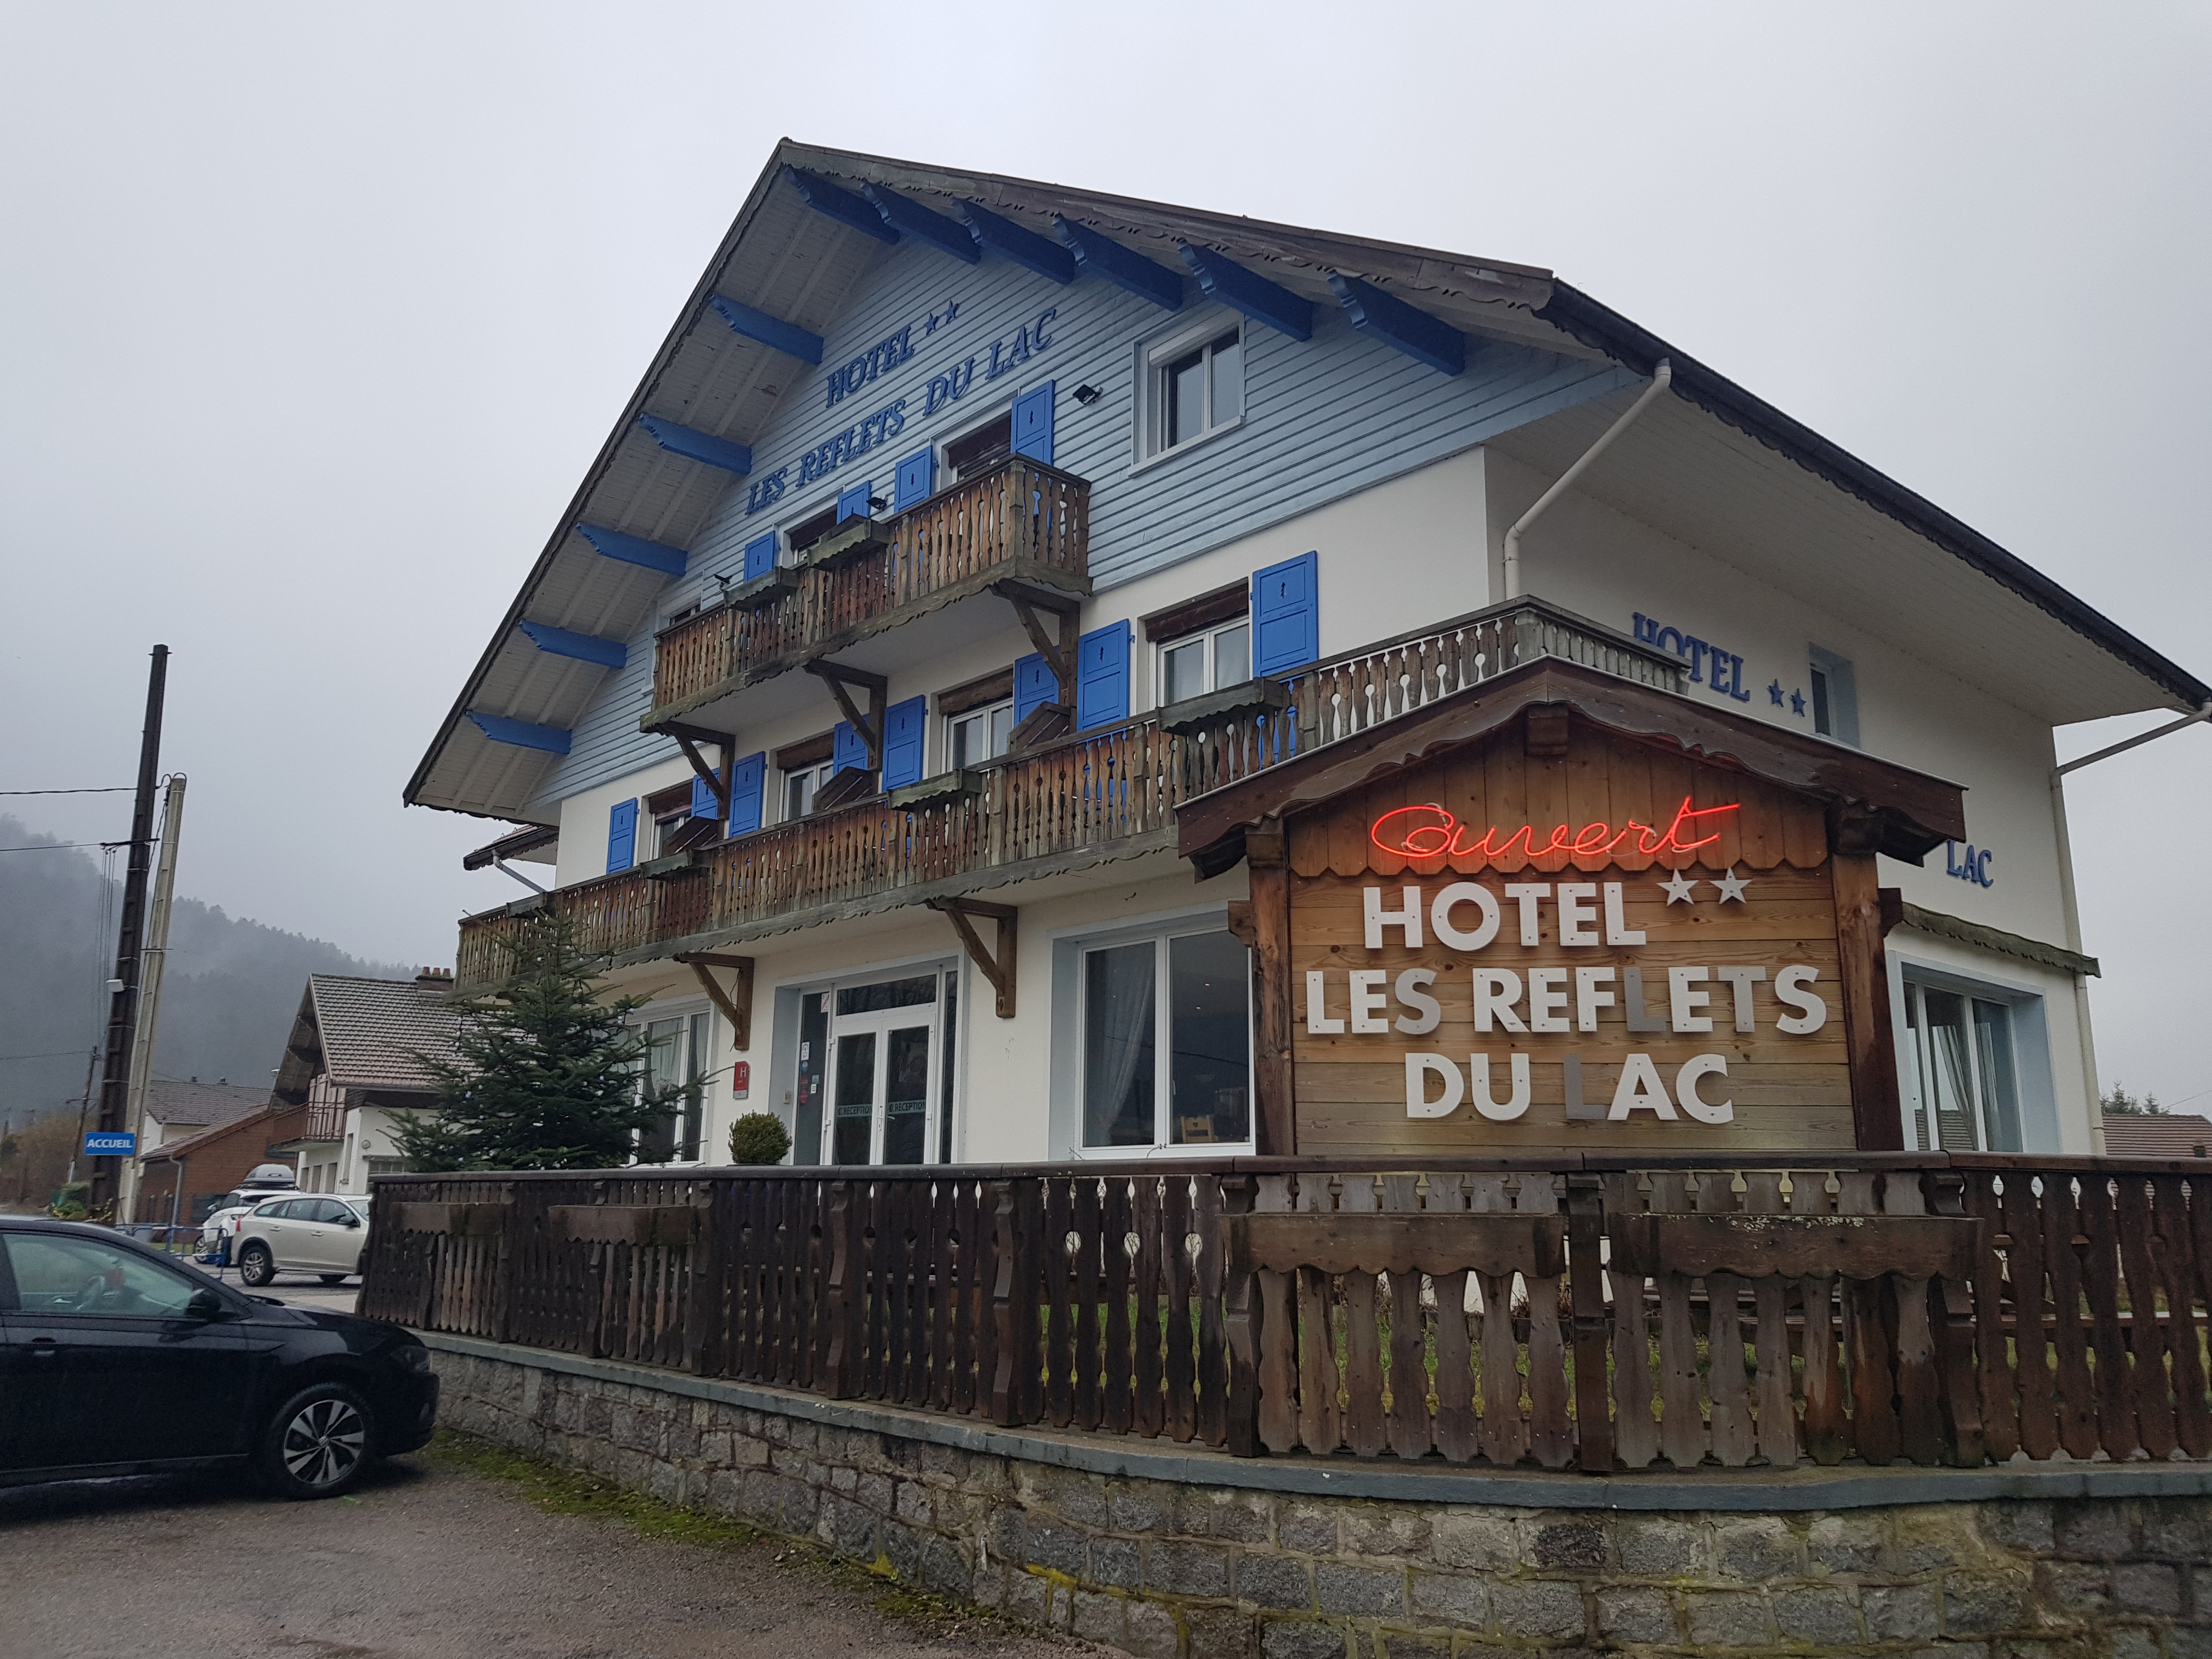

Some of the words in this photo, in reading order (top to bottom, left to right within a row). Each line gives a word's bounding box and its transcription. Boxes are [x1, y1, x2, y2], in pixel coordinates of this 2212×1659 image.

[826, 325, 914, 408] HOTEL
[744, 467, 788, 515] LES
[795, 399, 906, 487] REFLETS
[922, 357, 975, 416] DU
[985, 308, 1057, 380] LAC
[1946, 840, 1994, 887] LAC
[1363, 882, 1645, 951] HOTEL
[1306, 968, 1441, 1035] LES
[1472, 965, 1827, 1034] REFLETS
[740, 1066, 747, 1077] H
[1405, 1052, 1531, 1120] DU
[1564, 1053, 1734, 1124] LAC
[86, 1138, 133, 1148] ACCUEIL
